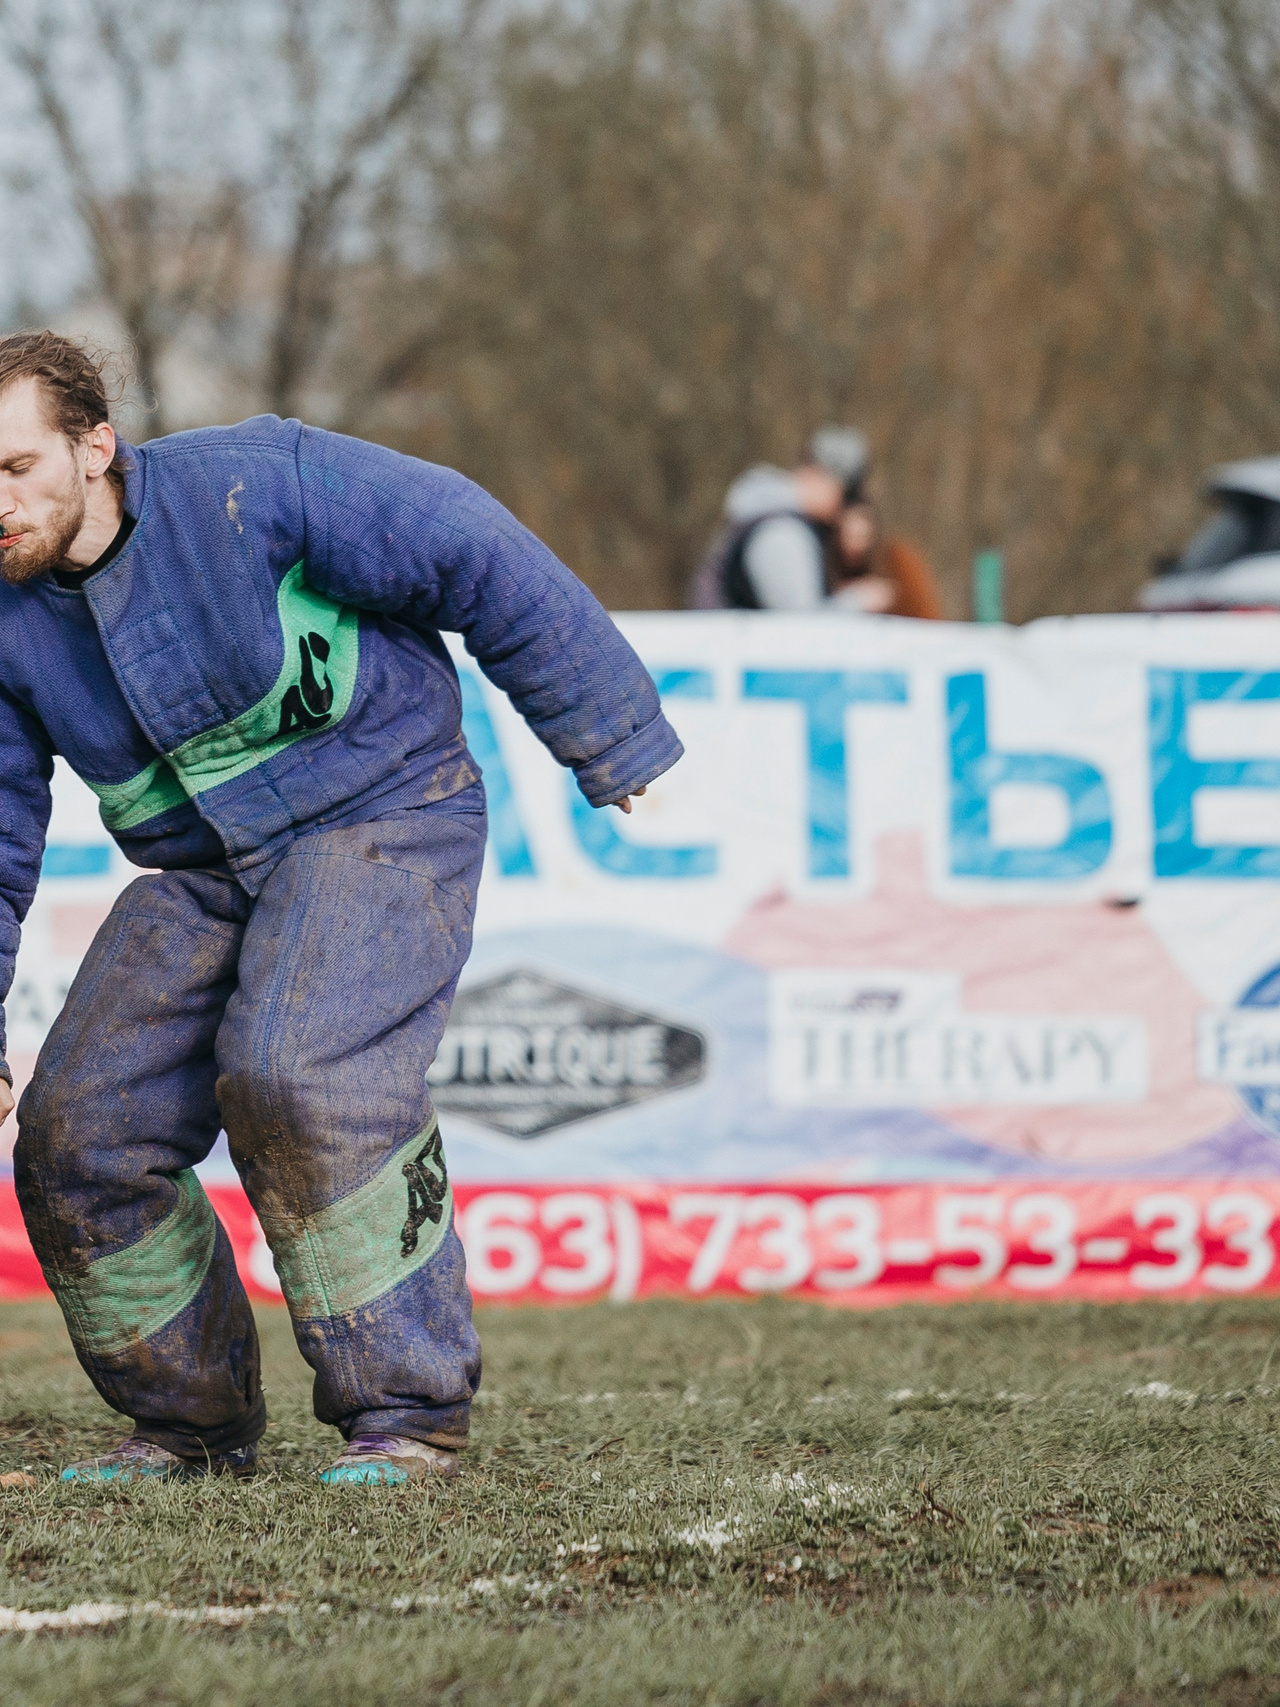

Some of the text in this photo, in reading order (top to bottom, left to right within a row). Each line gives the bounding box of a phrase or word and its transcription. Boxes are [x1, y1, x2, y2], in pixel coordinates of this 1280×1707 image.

[426, 1023, 669, 1087] UTRIQUE
[796, 1026, 1132, 1087] THERAPY
[458, 1191, 1275, 1306] 63) 733-53-33
